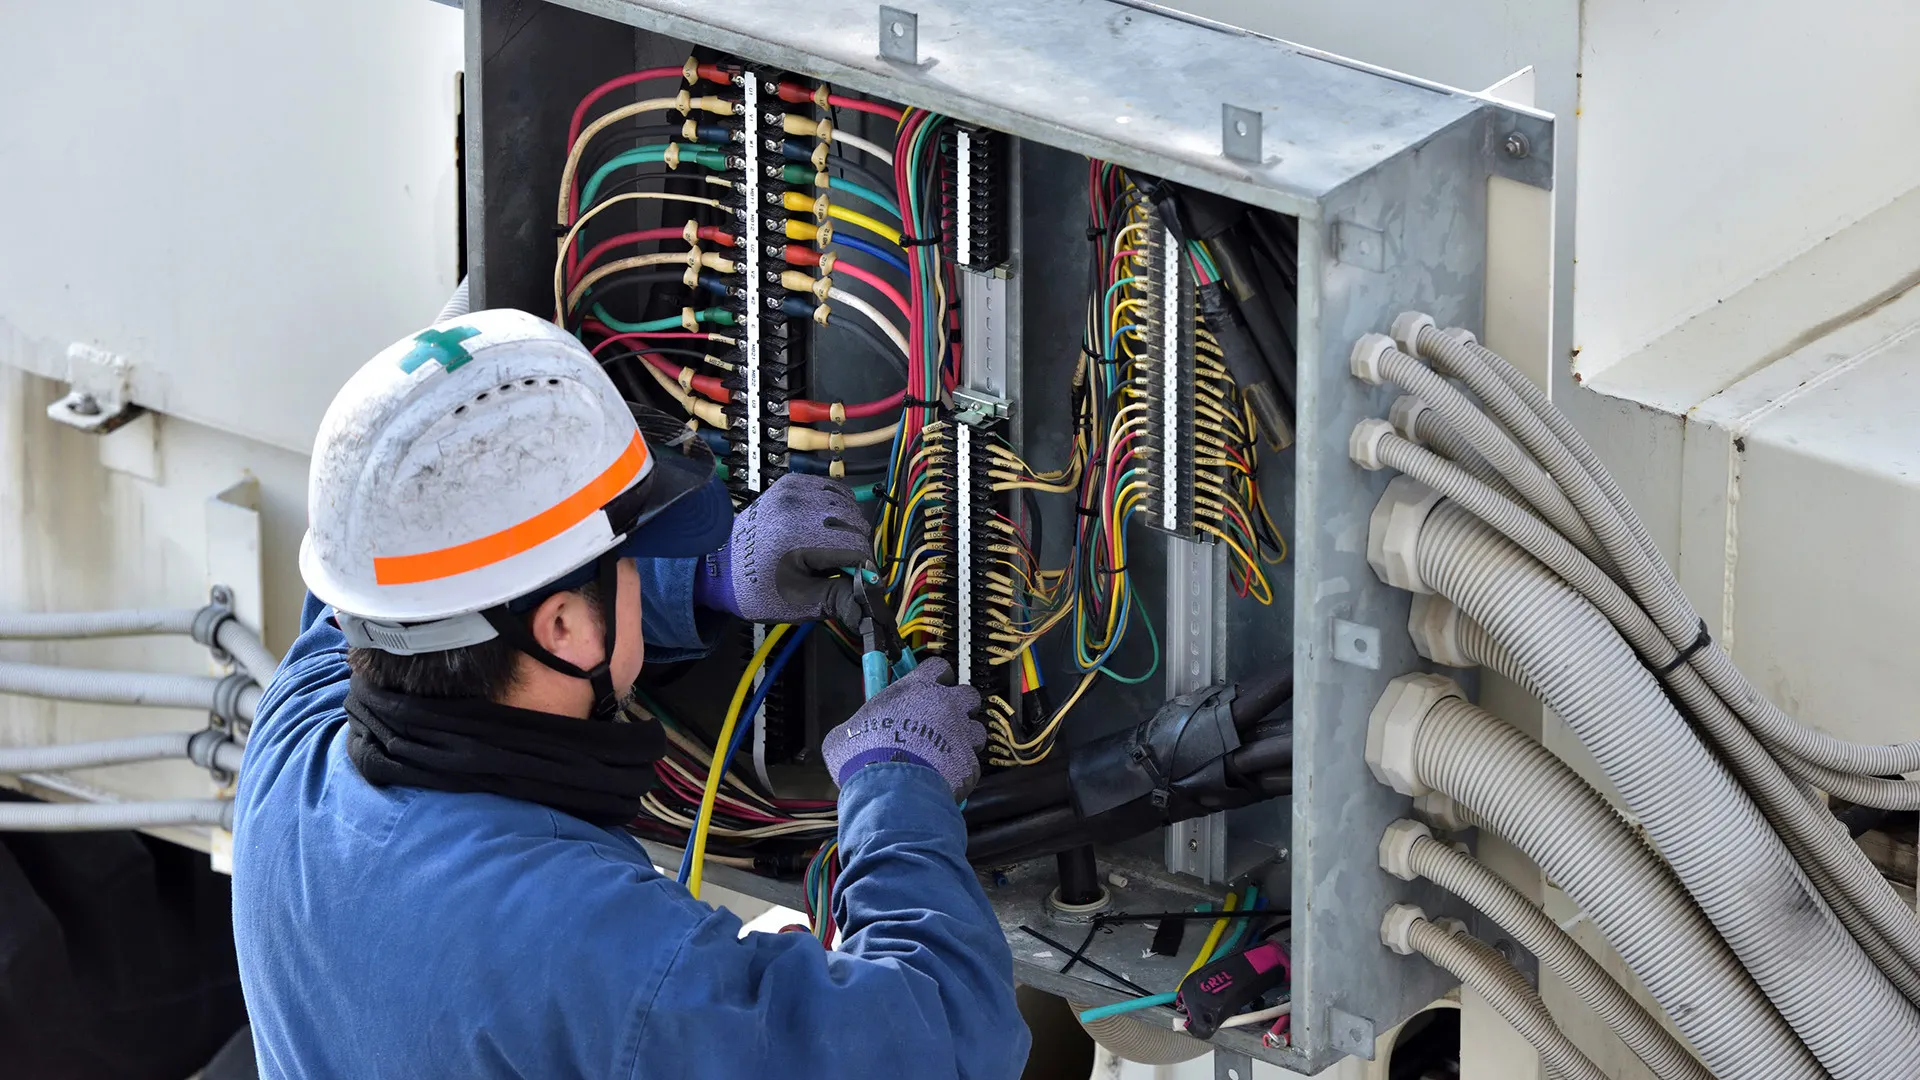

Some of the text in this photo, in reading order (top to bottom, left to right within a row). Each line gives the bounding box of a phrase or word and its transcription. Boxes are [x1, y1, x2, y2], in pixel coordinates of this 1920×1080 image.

[749, 87, 753, 96] U1
[751, 244, 755, 253] U2
[751, 270, 755, 279] V2
[752, 400, 757, 409] U3
[734, 527, 747, 542] L
[993, 544, 1009, 552] 1002
[846, 717, 894, 739] Lite
[894, 730, 907, 744] L
